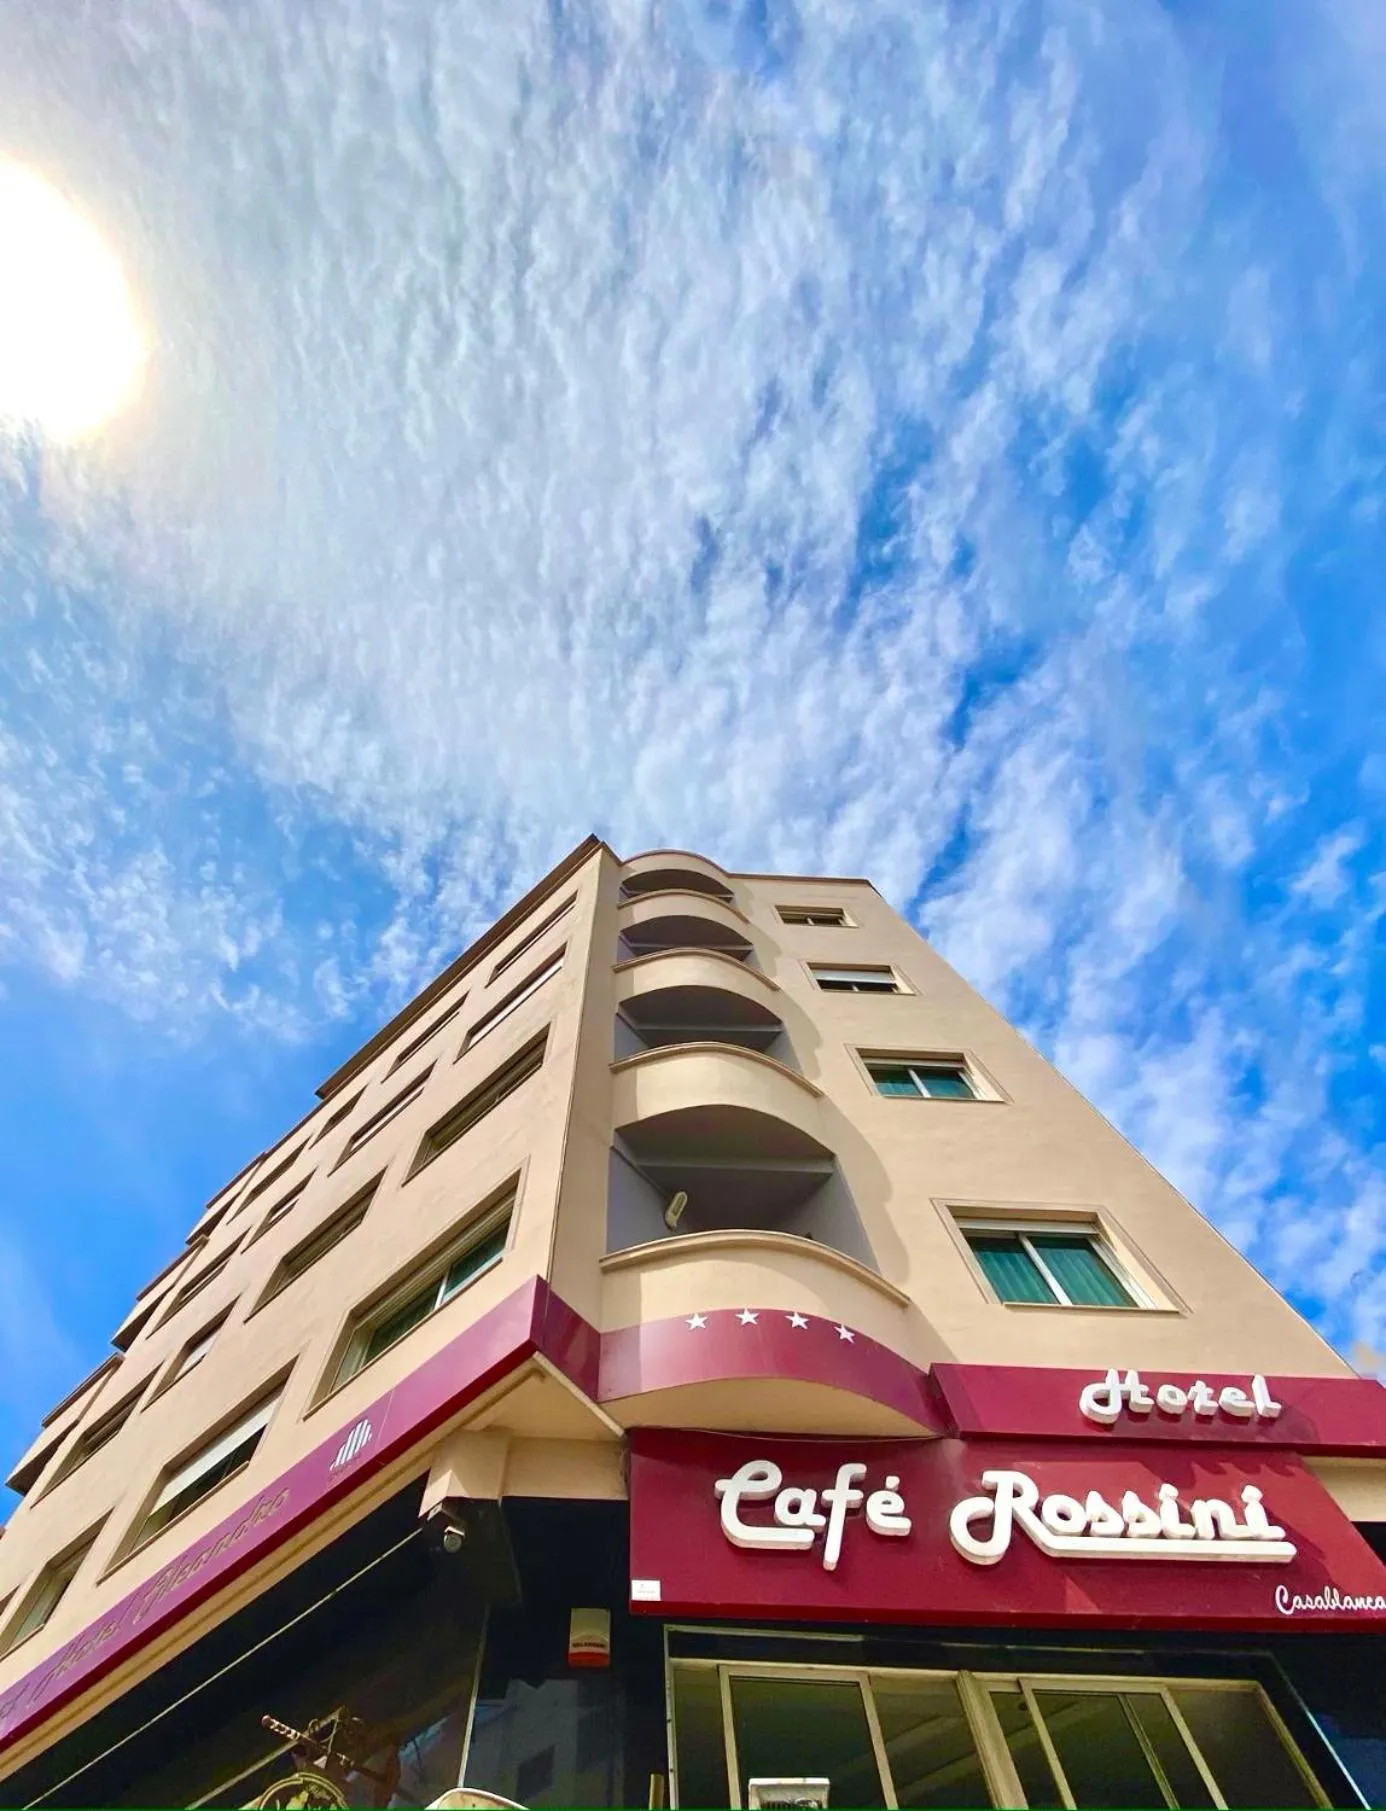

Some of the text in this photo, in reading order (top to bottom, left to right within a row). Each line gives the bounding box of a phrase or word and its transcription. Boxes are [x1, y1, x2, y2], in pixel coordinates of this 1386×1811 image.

[1079, 1368, 1282, 1424] Hotel
[714, 1459, 1297, 1571] Café Rossini
[1275, 1585, 1386, 1615] Casablanca
